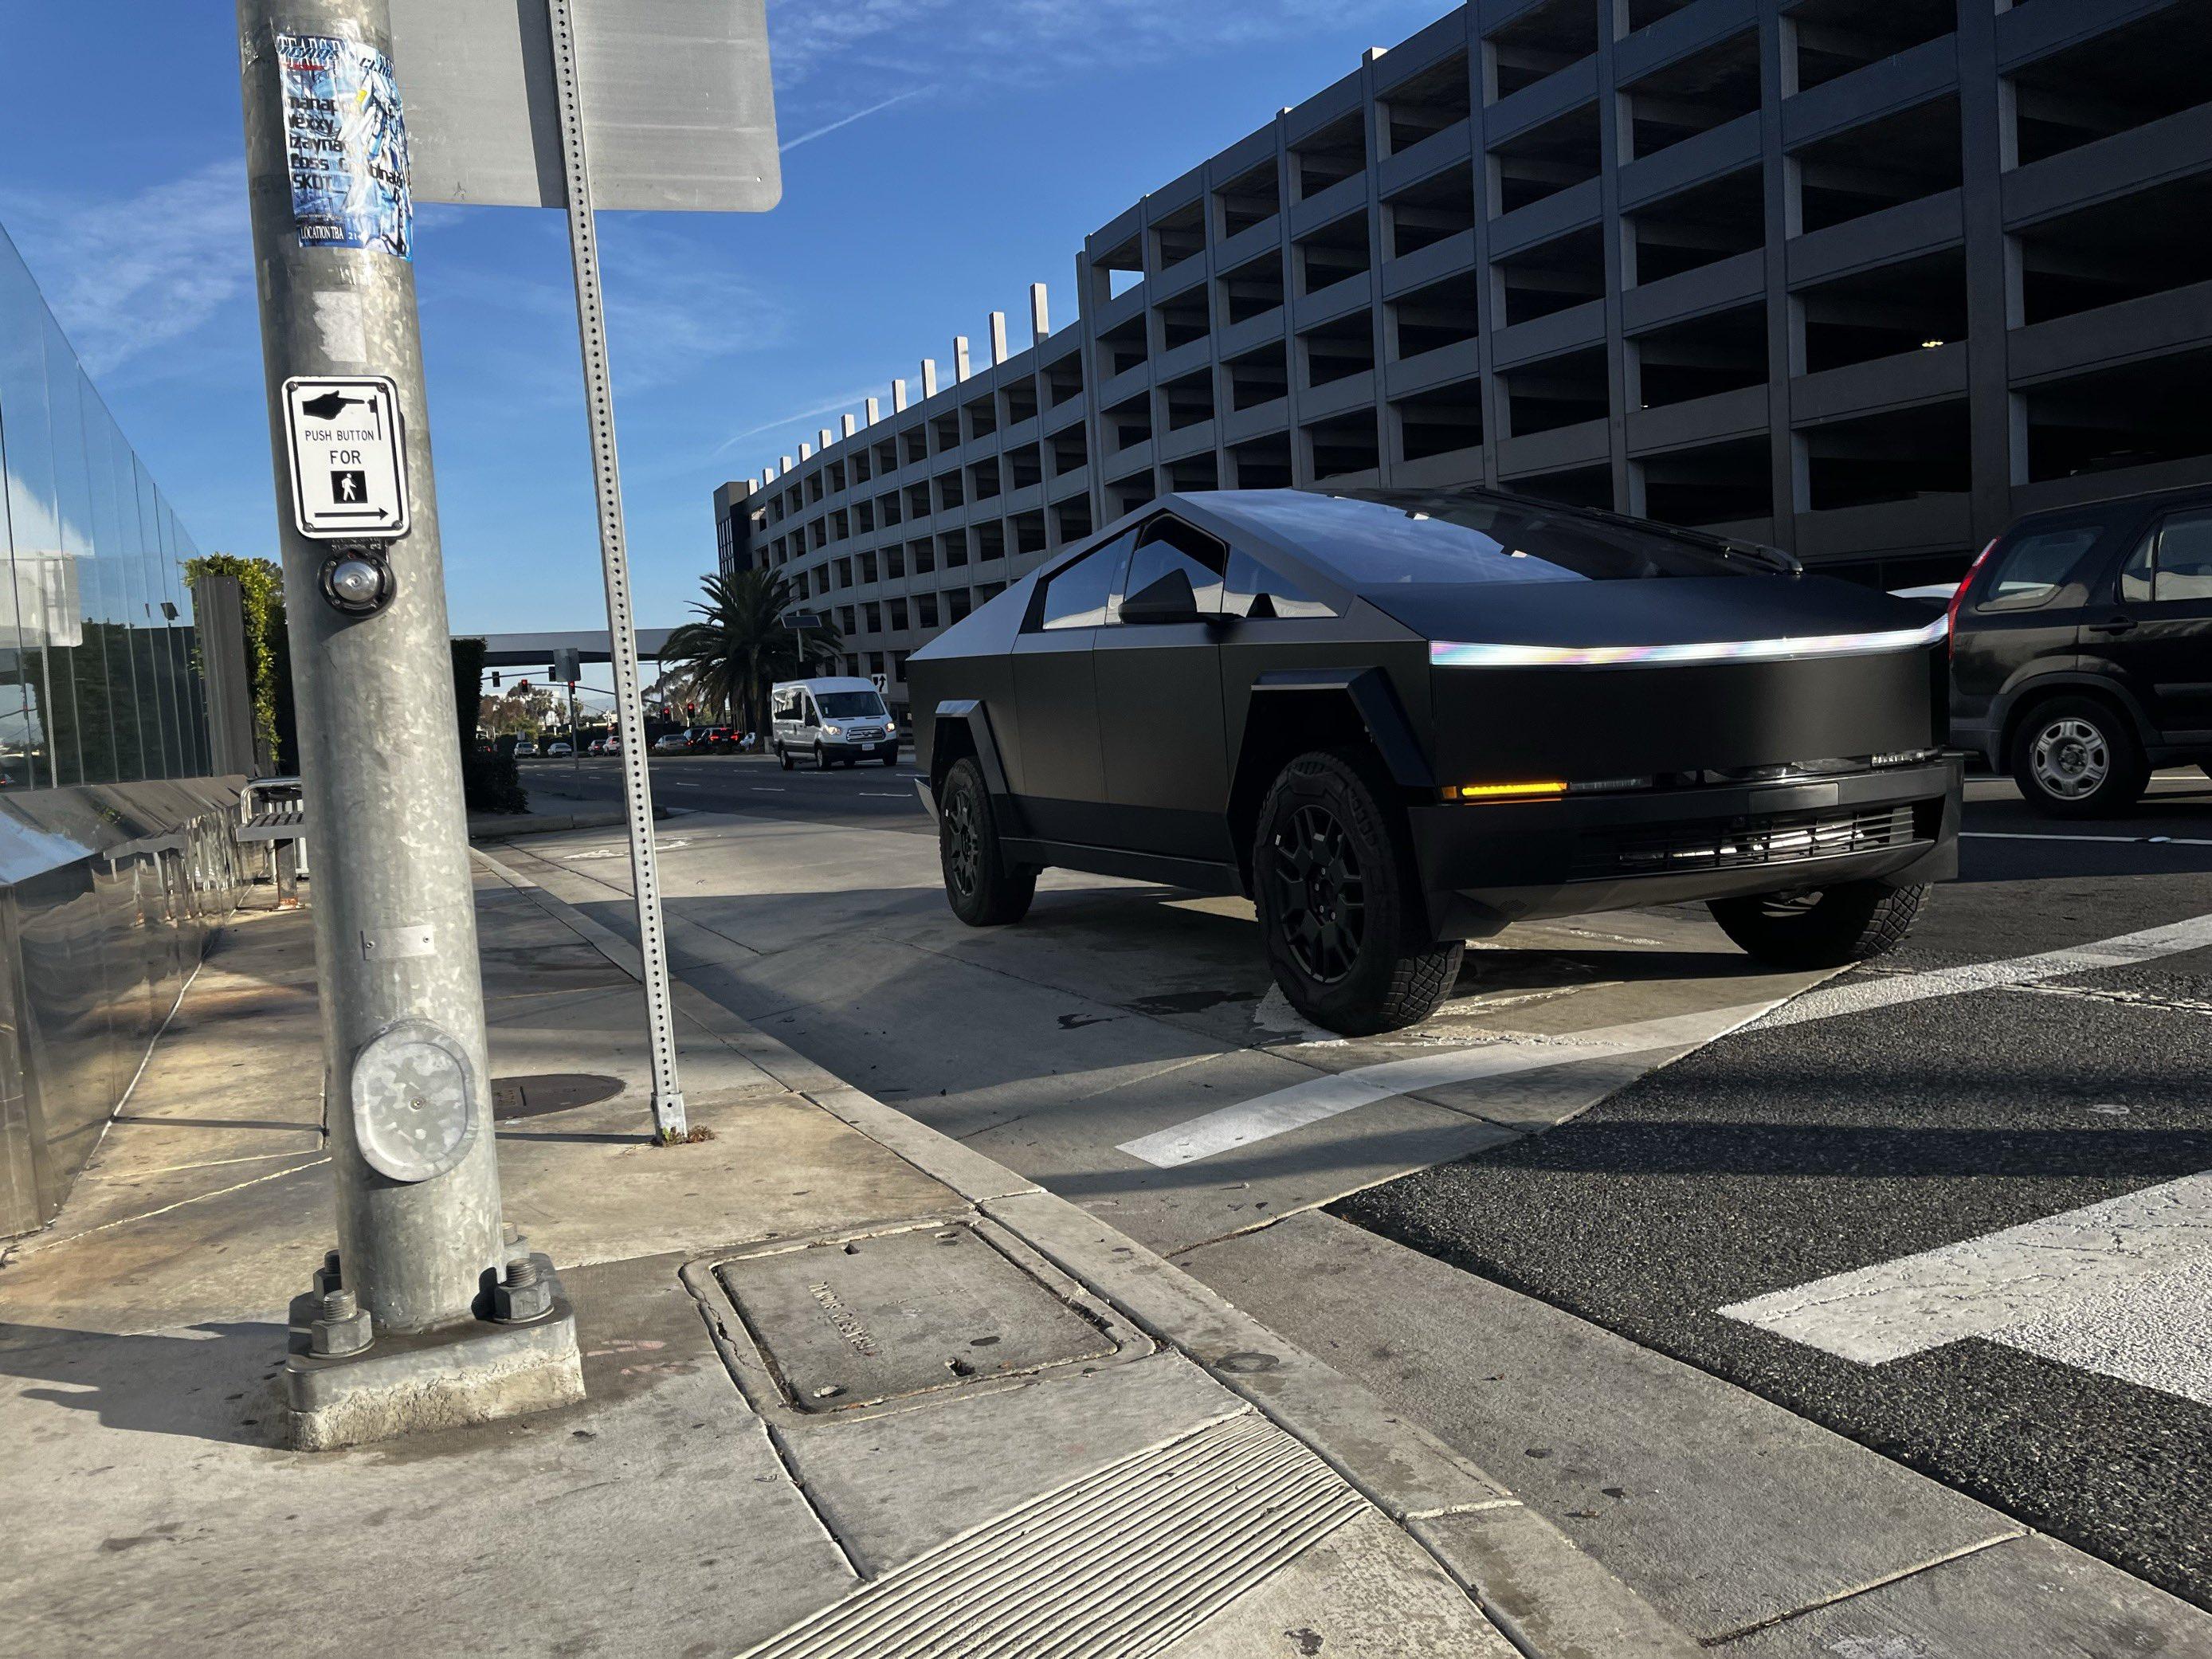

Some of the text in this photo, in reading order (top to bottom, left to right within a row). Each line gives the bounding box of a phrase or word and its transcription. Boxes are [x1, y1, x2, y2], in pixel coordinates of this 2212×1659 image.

[300, 226, 344, 240] LOCATION TBA
[304, 429, 375, 441] PUSH BUTTON
[330, 449, 362, 465] FOR
